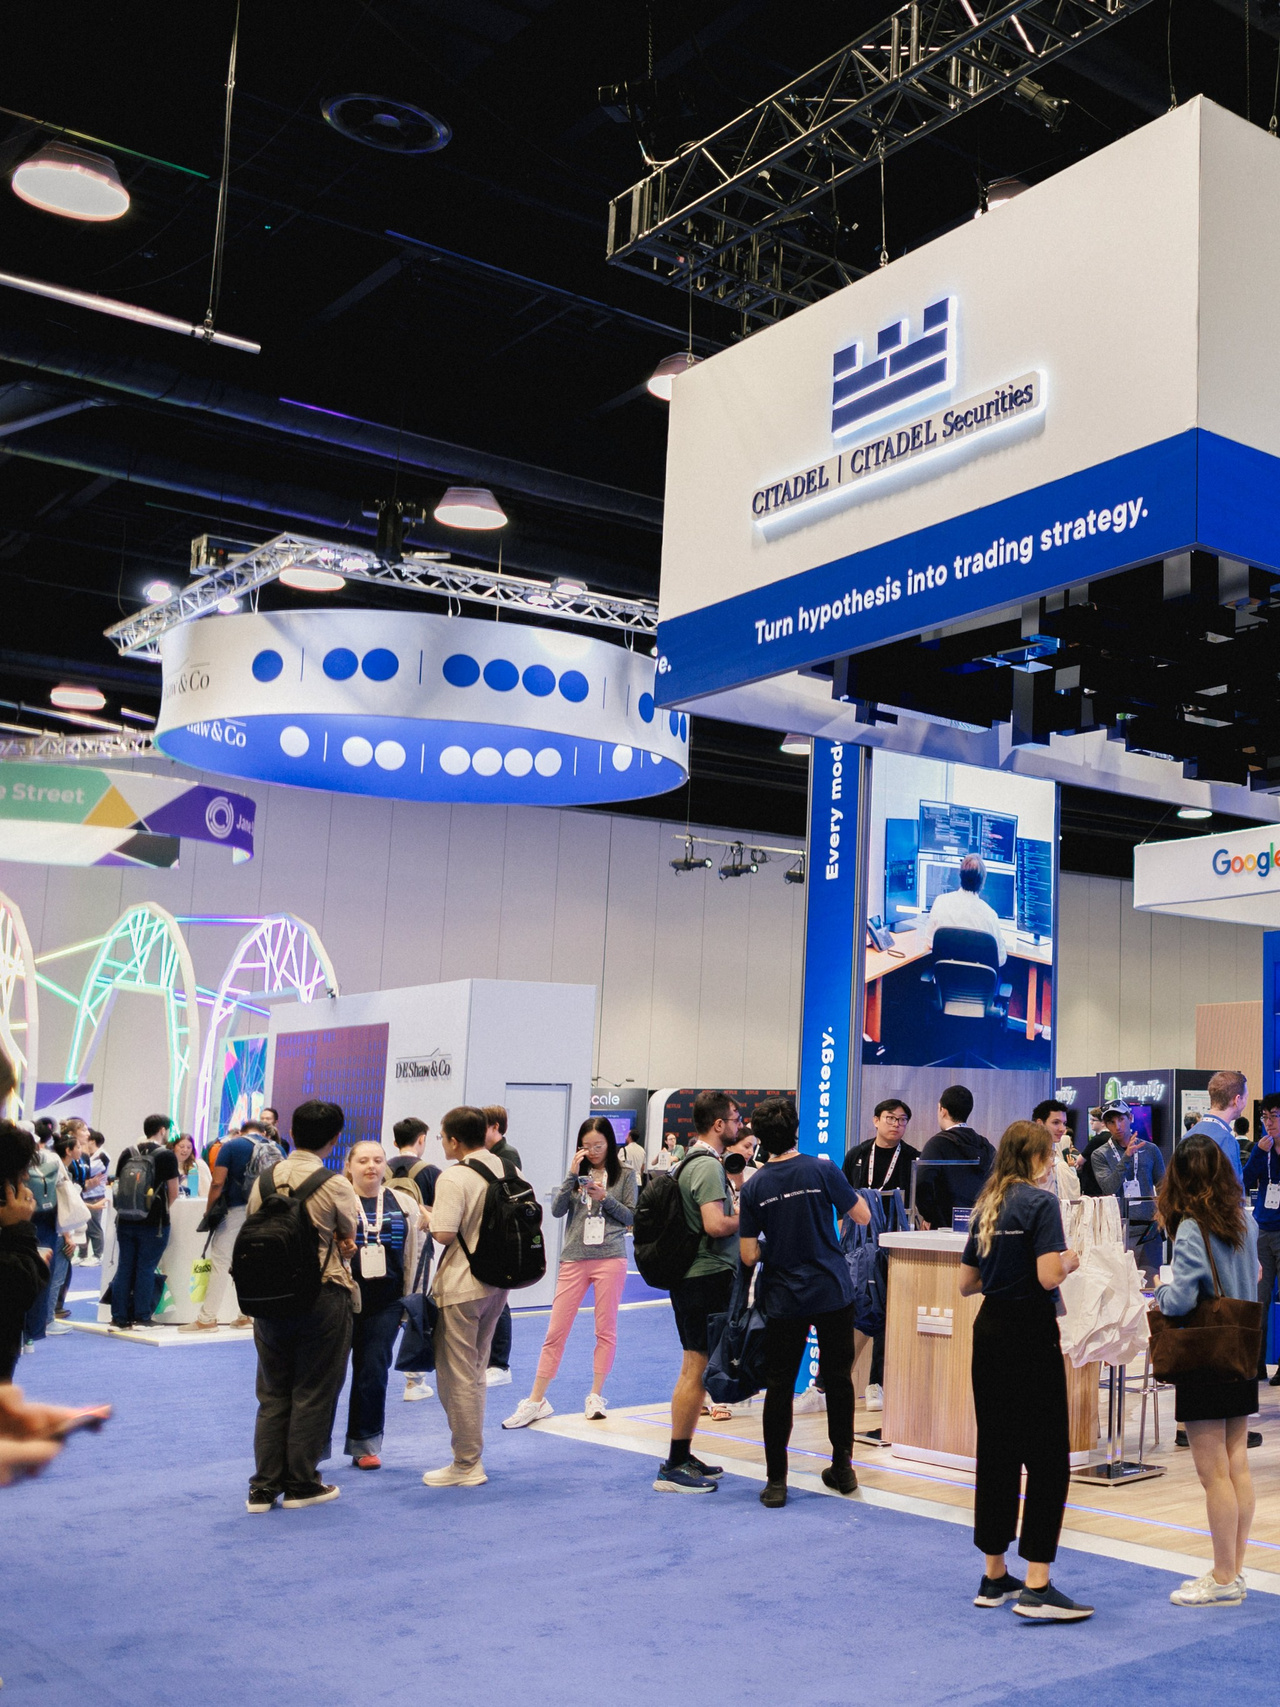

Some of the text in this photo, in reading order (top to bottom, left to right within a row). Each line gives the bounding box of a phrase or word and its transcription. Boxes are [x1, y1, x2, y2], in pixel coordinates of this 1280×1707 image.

[753, 383, 1034, 514] CITADEL CITADEL Securities
[755, 496, 1149, 645] Turn hypothesis into trading strategy.
[12, 783, 85, 804] Street
[825, 807, 844, 880] Every
[817, 1026, 835, 1144] strategy.
[1120, 1080, 1165, 1102] shopify
